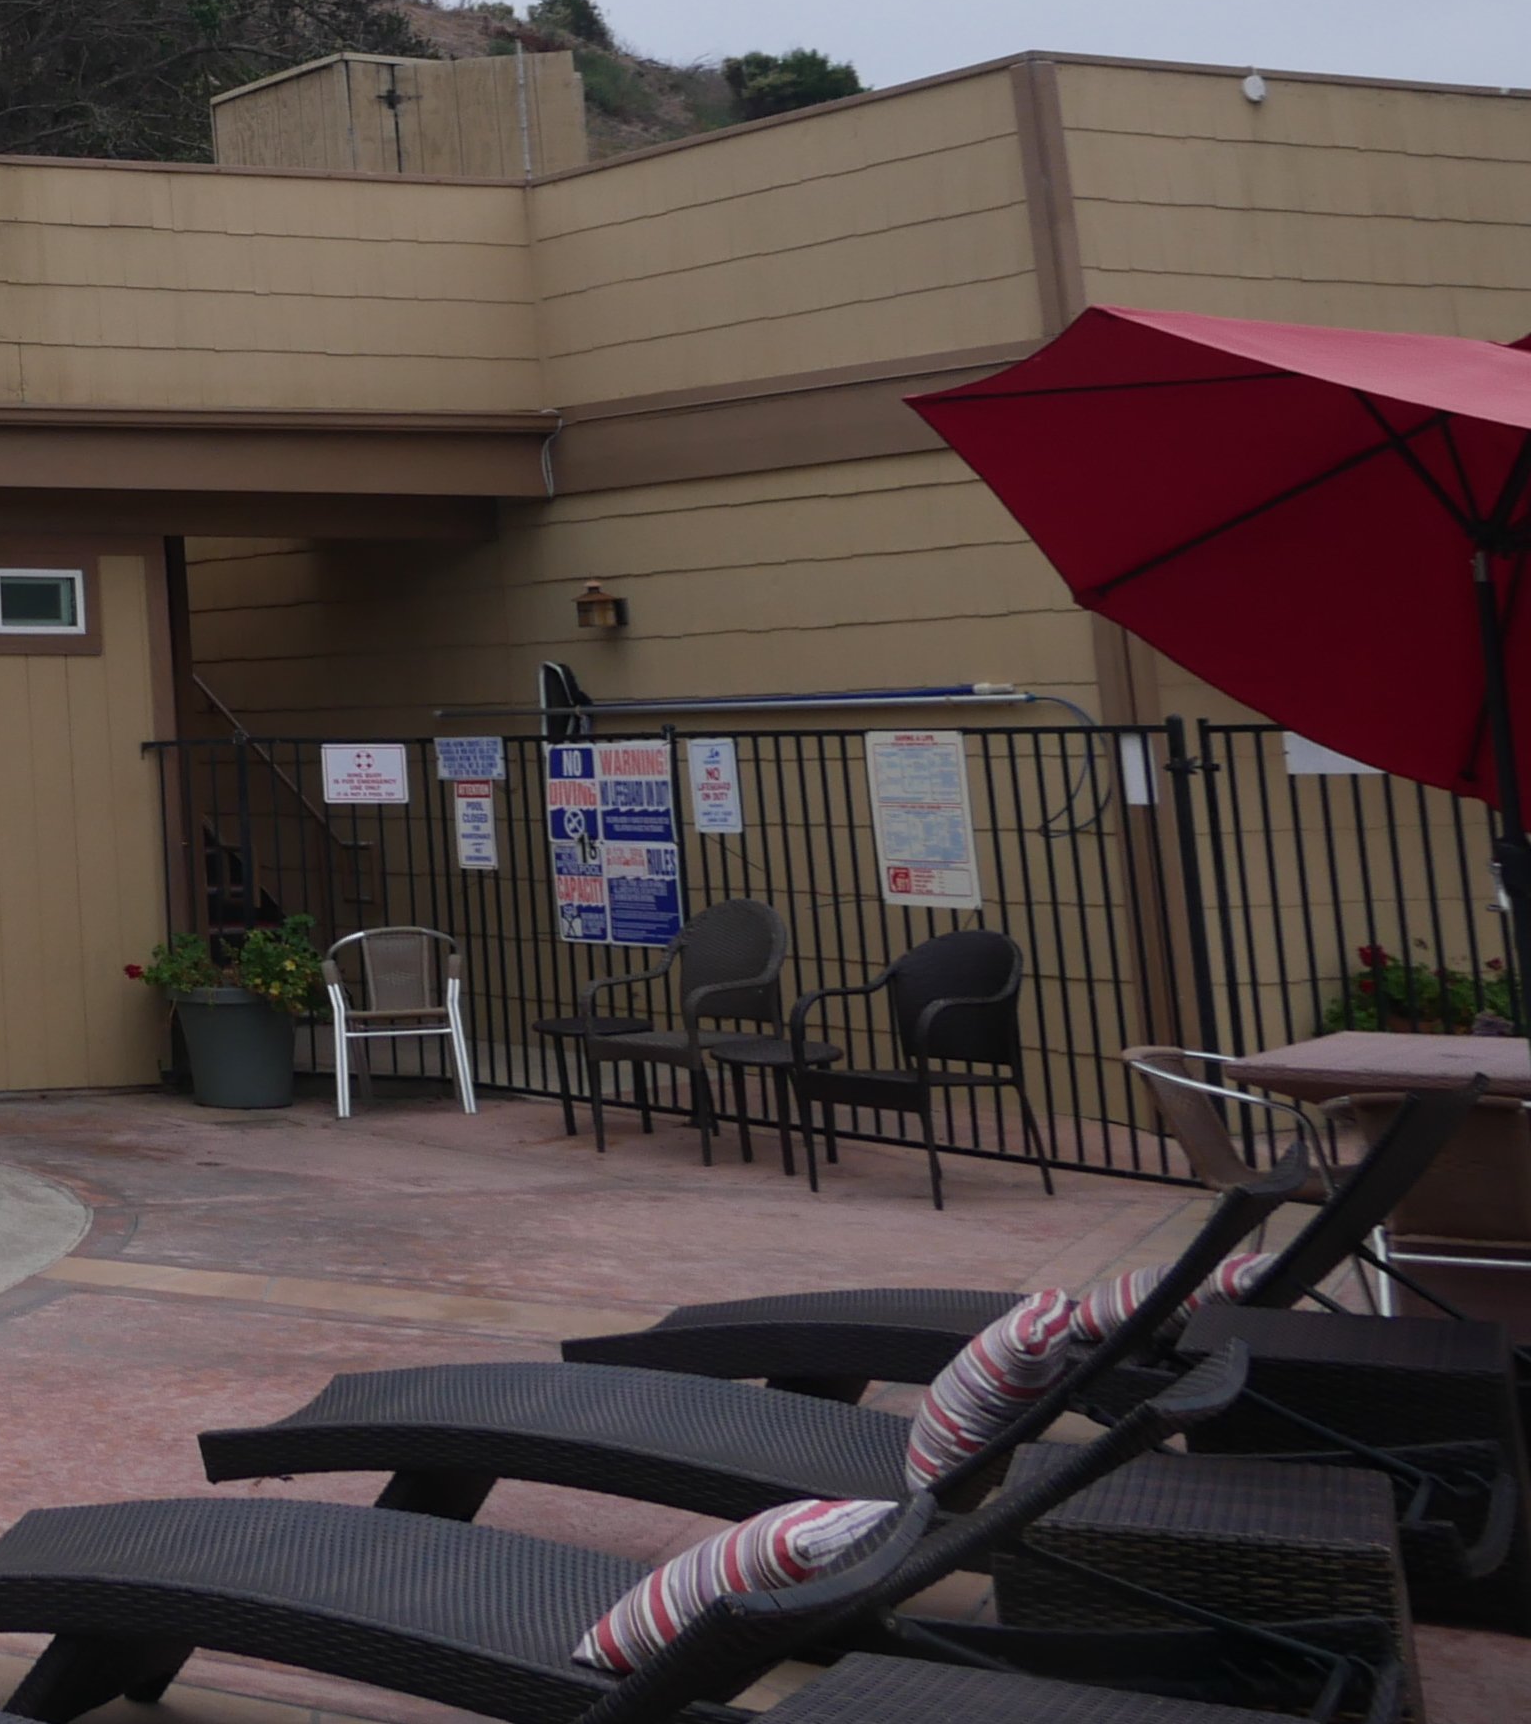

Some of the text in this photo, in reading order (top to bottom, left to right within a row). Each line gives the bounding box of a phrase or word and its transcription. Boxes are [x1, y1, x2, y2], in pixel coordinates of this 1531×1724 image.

[562, 750, 582, 776] NO
[705, 767, 721, 781] NO
[549, 780, 598, 806] DIVING
[557, 876, 604, 903] CAPACITY
